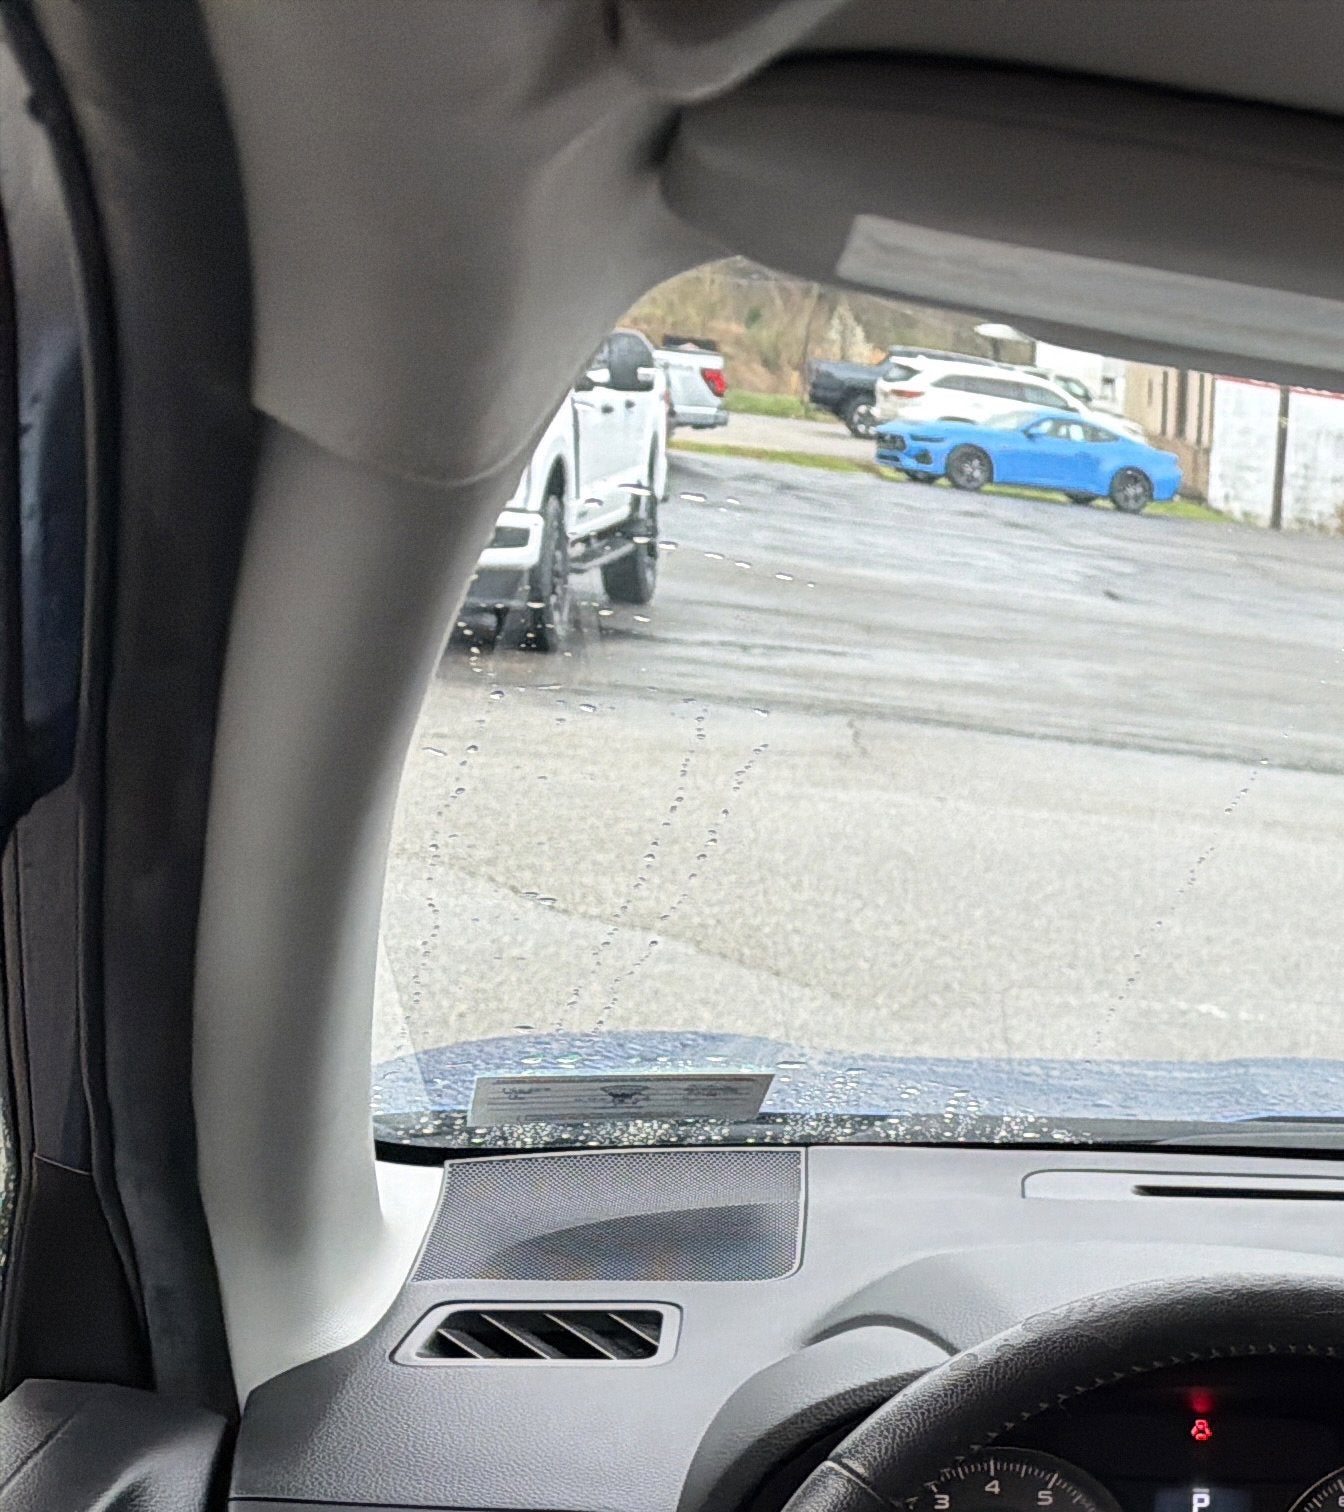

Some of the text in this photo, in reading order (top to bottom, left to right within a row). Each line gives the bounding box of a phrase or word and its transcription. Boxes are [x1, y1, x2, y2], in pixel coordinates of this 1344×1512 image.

[985, 1480, 1000, 1494] 4
[934, 1494, 950, 1509] 3
[1037, 1491, 1053, 1505] 5
